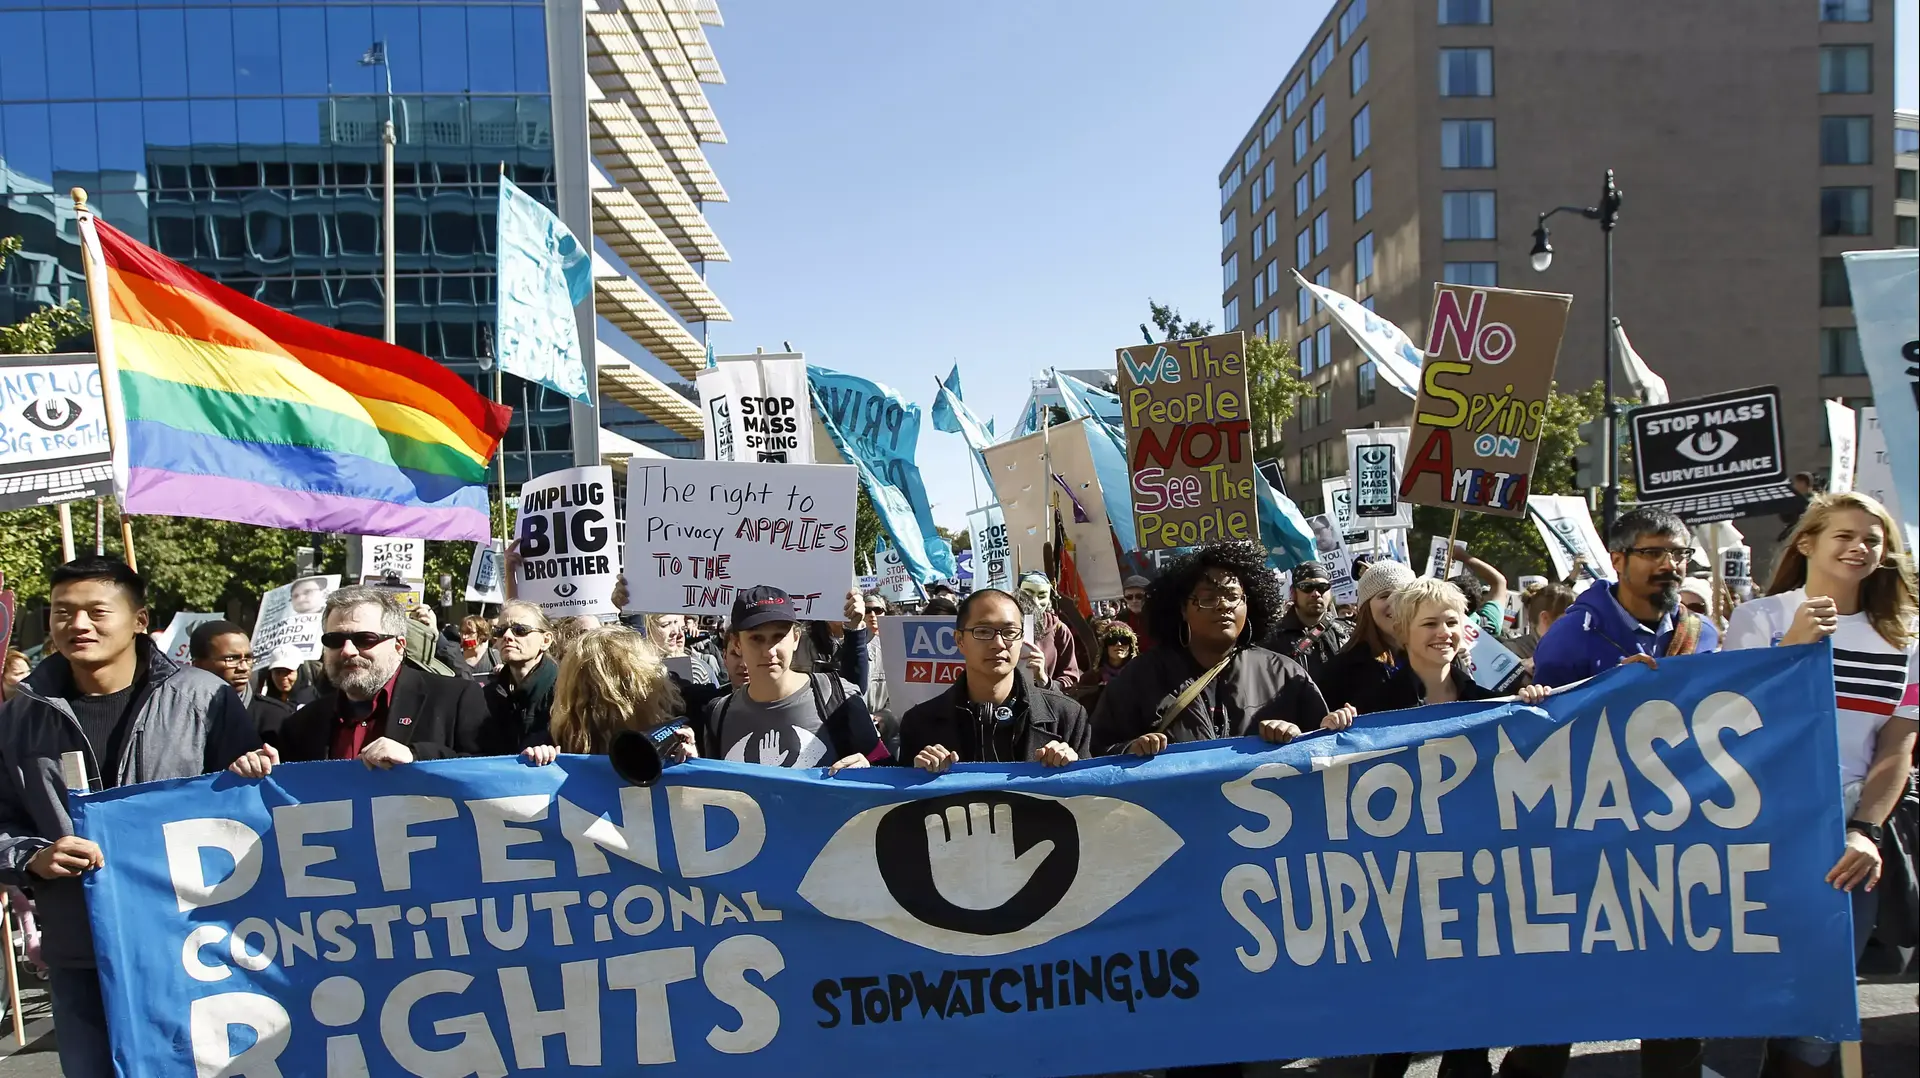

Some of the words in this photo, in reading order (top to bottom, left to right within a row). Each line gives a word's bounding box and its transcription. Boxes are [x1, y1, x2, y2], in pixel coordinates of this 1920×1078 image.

[1426, 290, 1515, 364] No
[1121, 346, 1181, 385] We
[1179, 341, 1240, 380] The
[740, 396, 795, 416] STOP
[1127, 382, 1240, 429] People
[743, 416, 797, 434] MASS
[1646, 414, 1699, 436] STOP
[1704, 403, 1765, 427] MASS
[746, 435, 798, 450] SPYING
[1133, 420, 1251, 472] NOT
[1474, 434, 1520, 458] ON
[1361, 470, 1388, 479] STOP
[1650, 456, 1772, 485] SURVEILLANCE
[639, 465, 696, 506] The
[710, 482, 773, 515] right
[788, 485, 814, 513] to
[1133, 467, 1202, 514] See
[1199, 463, 1253, 503] The
[1361, 480, 1388, 488] MASS
[523, 482, 605, 515] UNPLUG
[519, 508, 608, 557] BIG
[647, 516, 724, 551] Privacy
[735, 517, 849, 553] APPLIES
[979, 524, 1006, 543] STOP
[1138, 508, 1249, 550] People
[373, 542, 414, 554] STOP
[373, 553, 413, 563] MASS
[373, 562, 412, 571] SPYING
[523, 555, 610, 580] BROTHER
[652, 553, 683, 578] TO
[688, 554, 731, 581] THE
[886, 565, 905, 576] STOP
[879, 575, 913, 586] WATCHIN
[892, 584, 904, 592] US
[539, 598, 598, 609] stopwatching.us
[255, 625, 304, 646] EDWARD
[260, 619, 288, 635] THANK
[253, 634, 313, 654] SNOWDEN!
[1220, 735, 1478, 849] STOP
[1492, 690, 1764, 832] MASS
[162, 785, 767, 913] DEFEND
